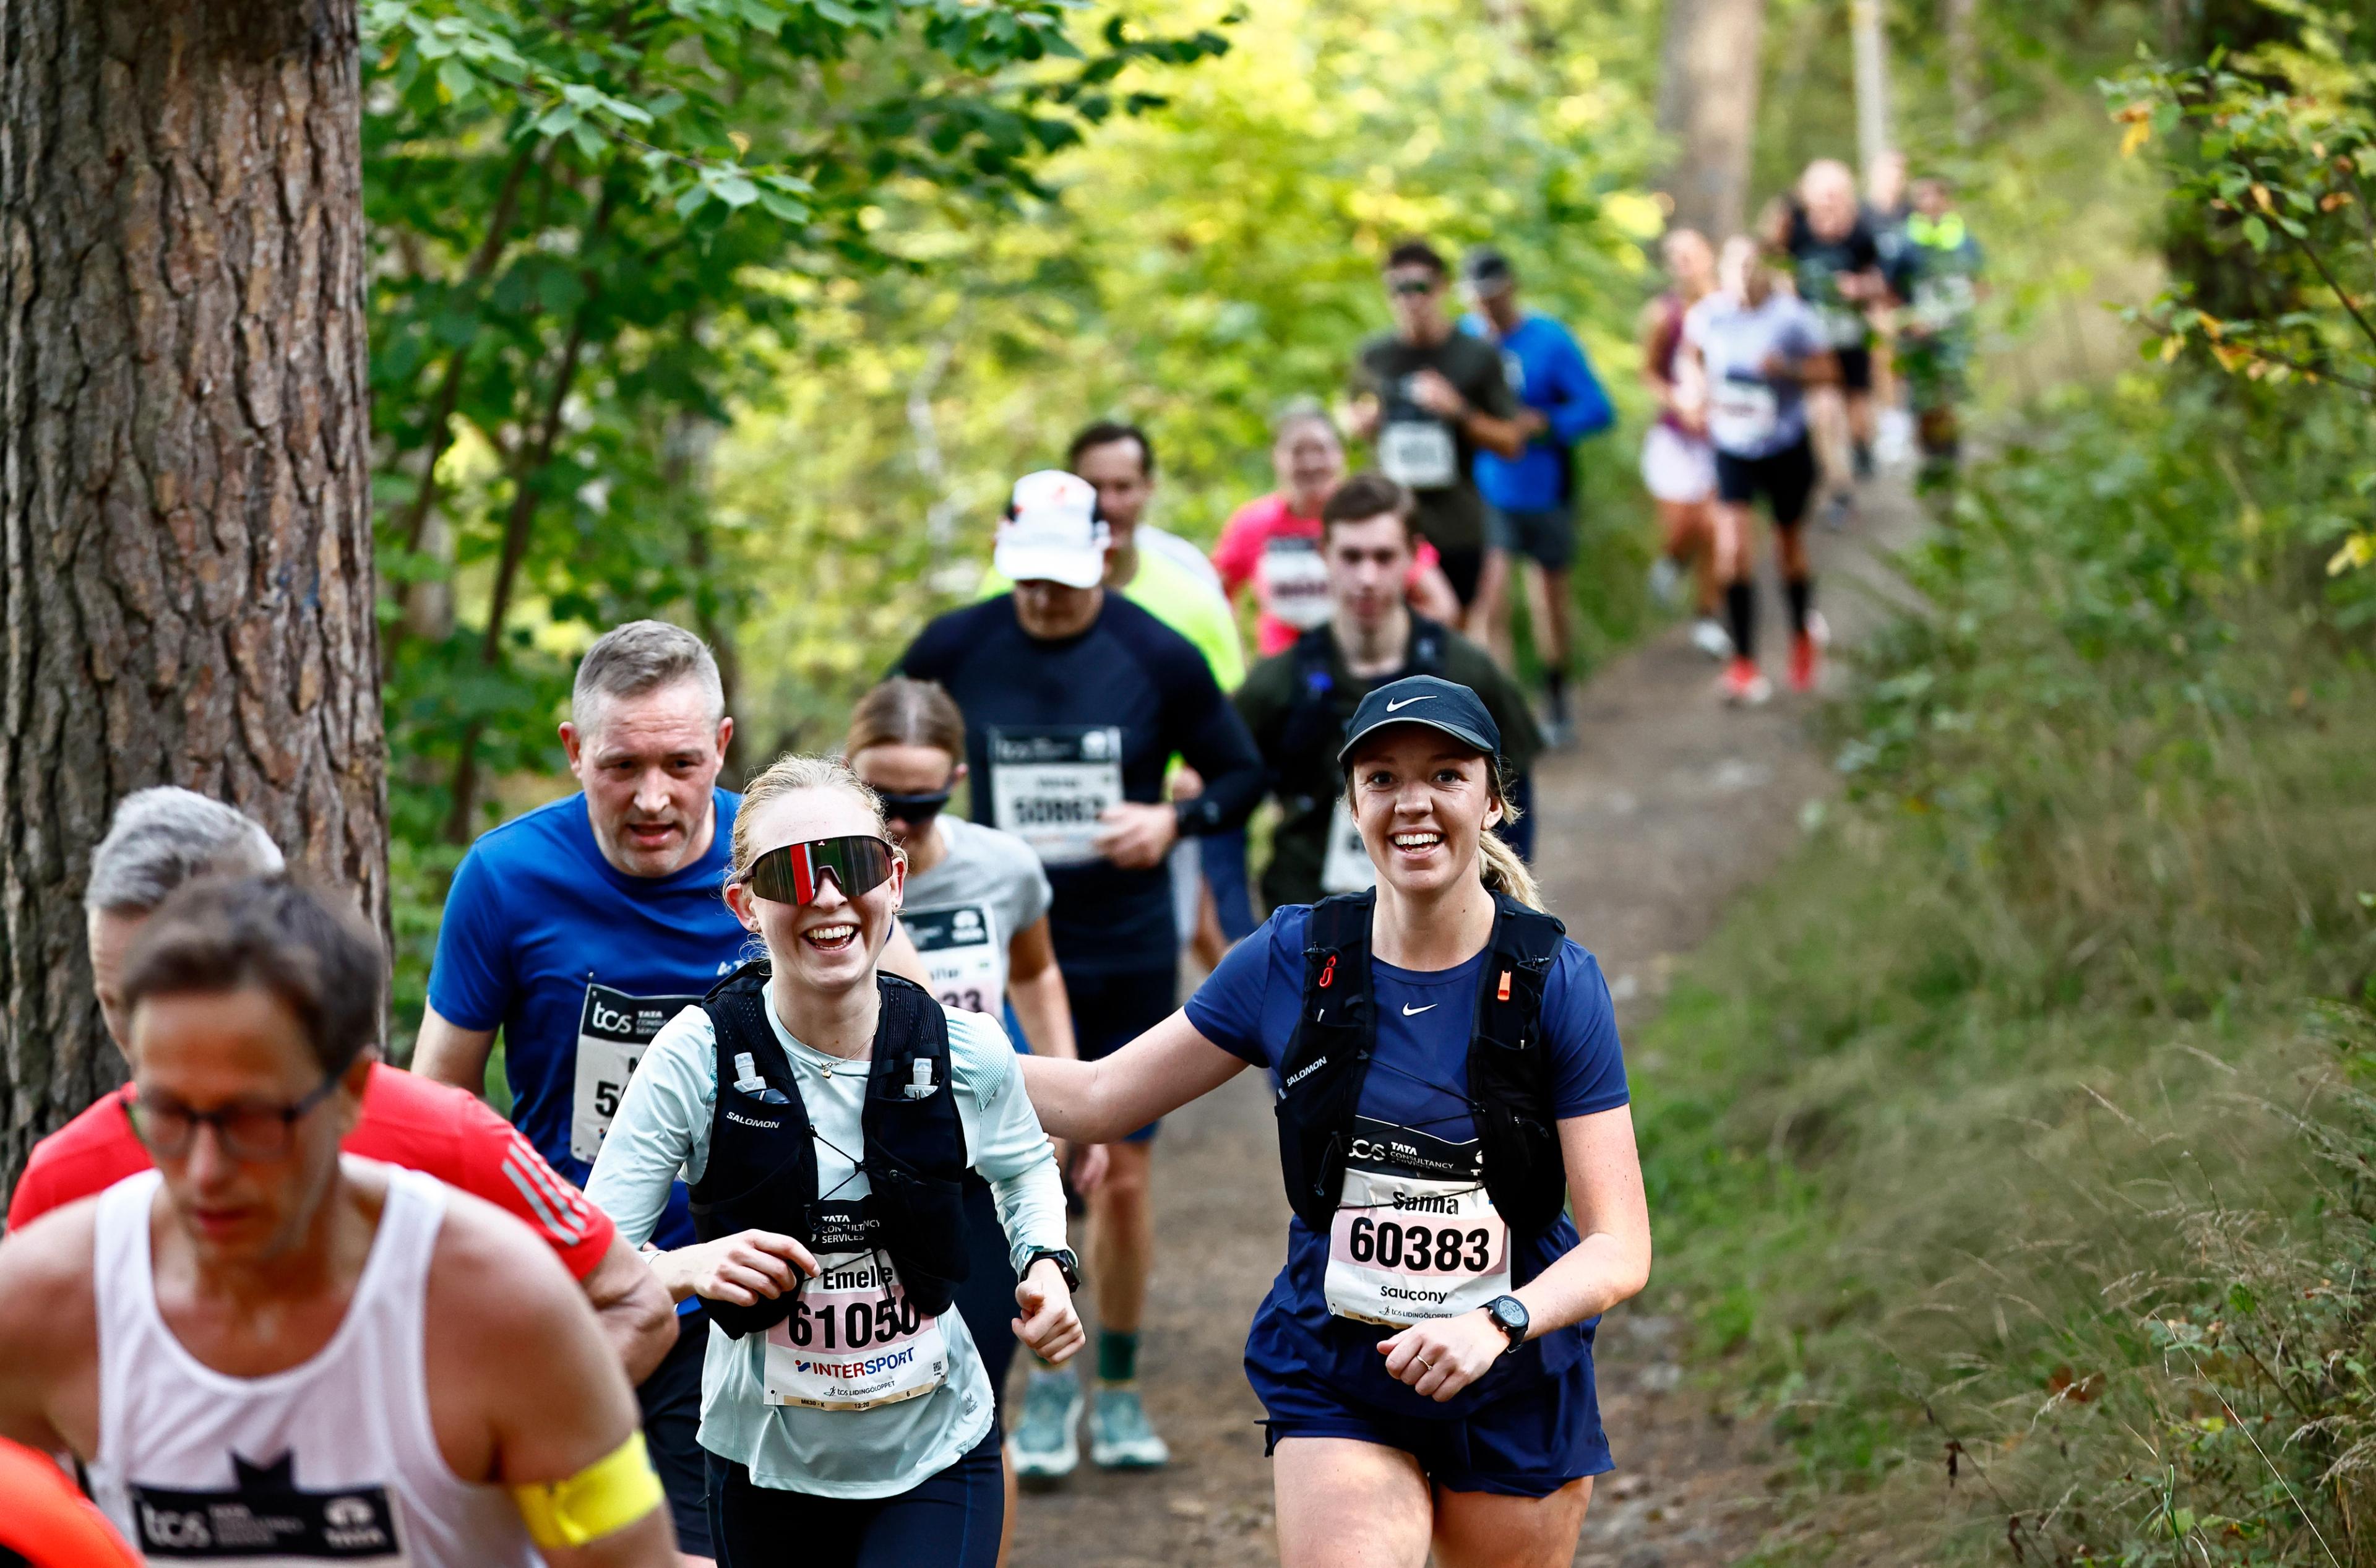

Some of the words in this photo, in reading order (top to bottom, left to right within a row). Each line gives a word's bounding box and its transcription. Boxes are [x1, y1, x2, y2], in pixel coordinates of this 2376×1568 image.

[592, 1001, 632, 1035] tcs
[1287, 1056, 1327, 1087] SALOMON
[726, 1111, 780, 1129] SALOMON
[1390, 1142, 1418, 1156] TATA
[1390, 1151, 1454, 1169] CONSULTANCY
[822, 1215, 850, 1223] TATA
[822, 1234, 864, 1243] SERVICES
[1350, 1217, 1490, 1272] 60383
[1380, 1285, 1448, 1304] saucony
[788, 1296, 921, 1349] 61050
[812, 1347, 915, 1379] INTERSPORT
